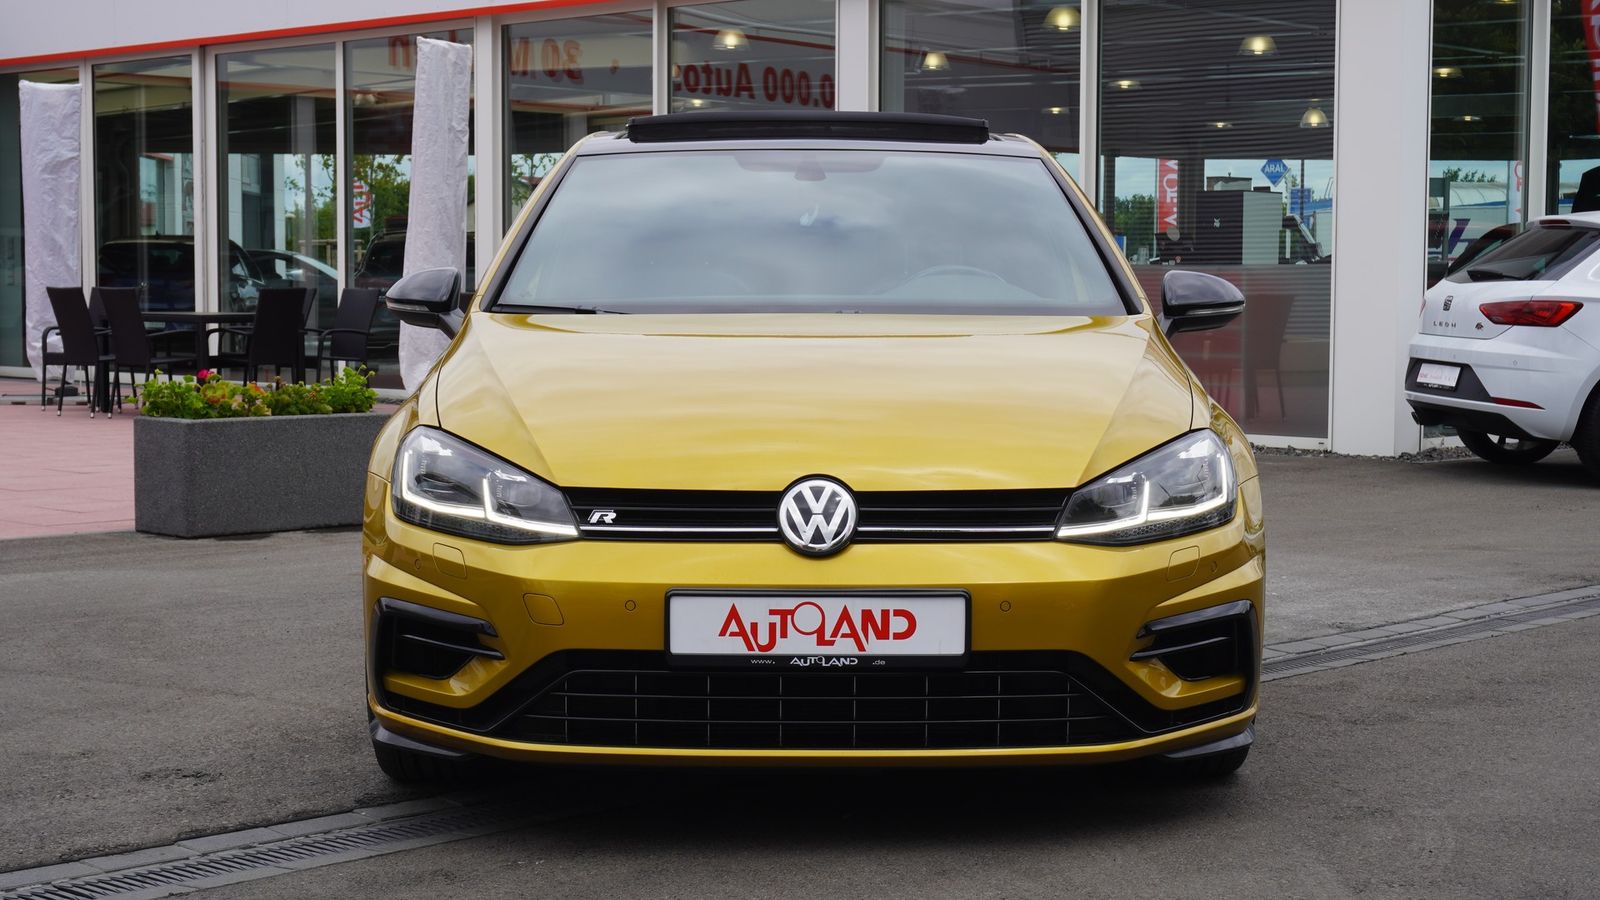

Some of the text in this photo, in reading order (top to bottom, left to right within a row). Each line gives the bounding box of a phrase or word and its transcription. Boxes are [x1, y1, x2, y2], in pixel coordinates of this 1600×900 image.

[1263, 163, 1285, 173] ARAL
[588, 509, 617, 524] R
[718, 601, 917, 652] AUTOLAND
[790, 656, 859, 667] AUTOLAND
